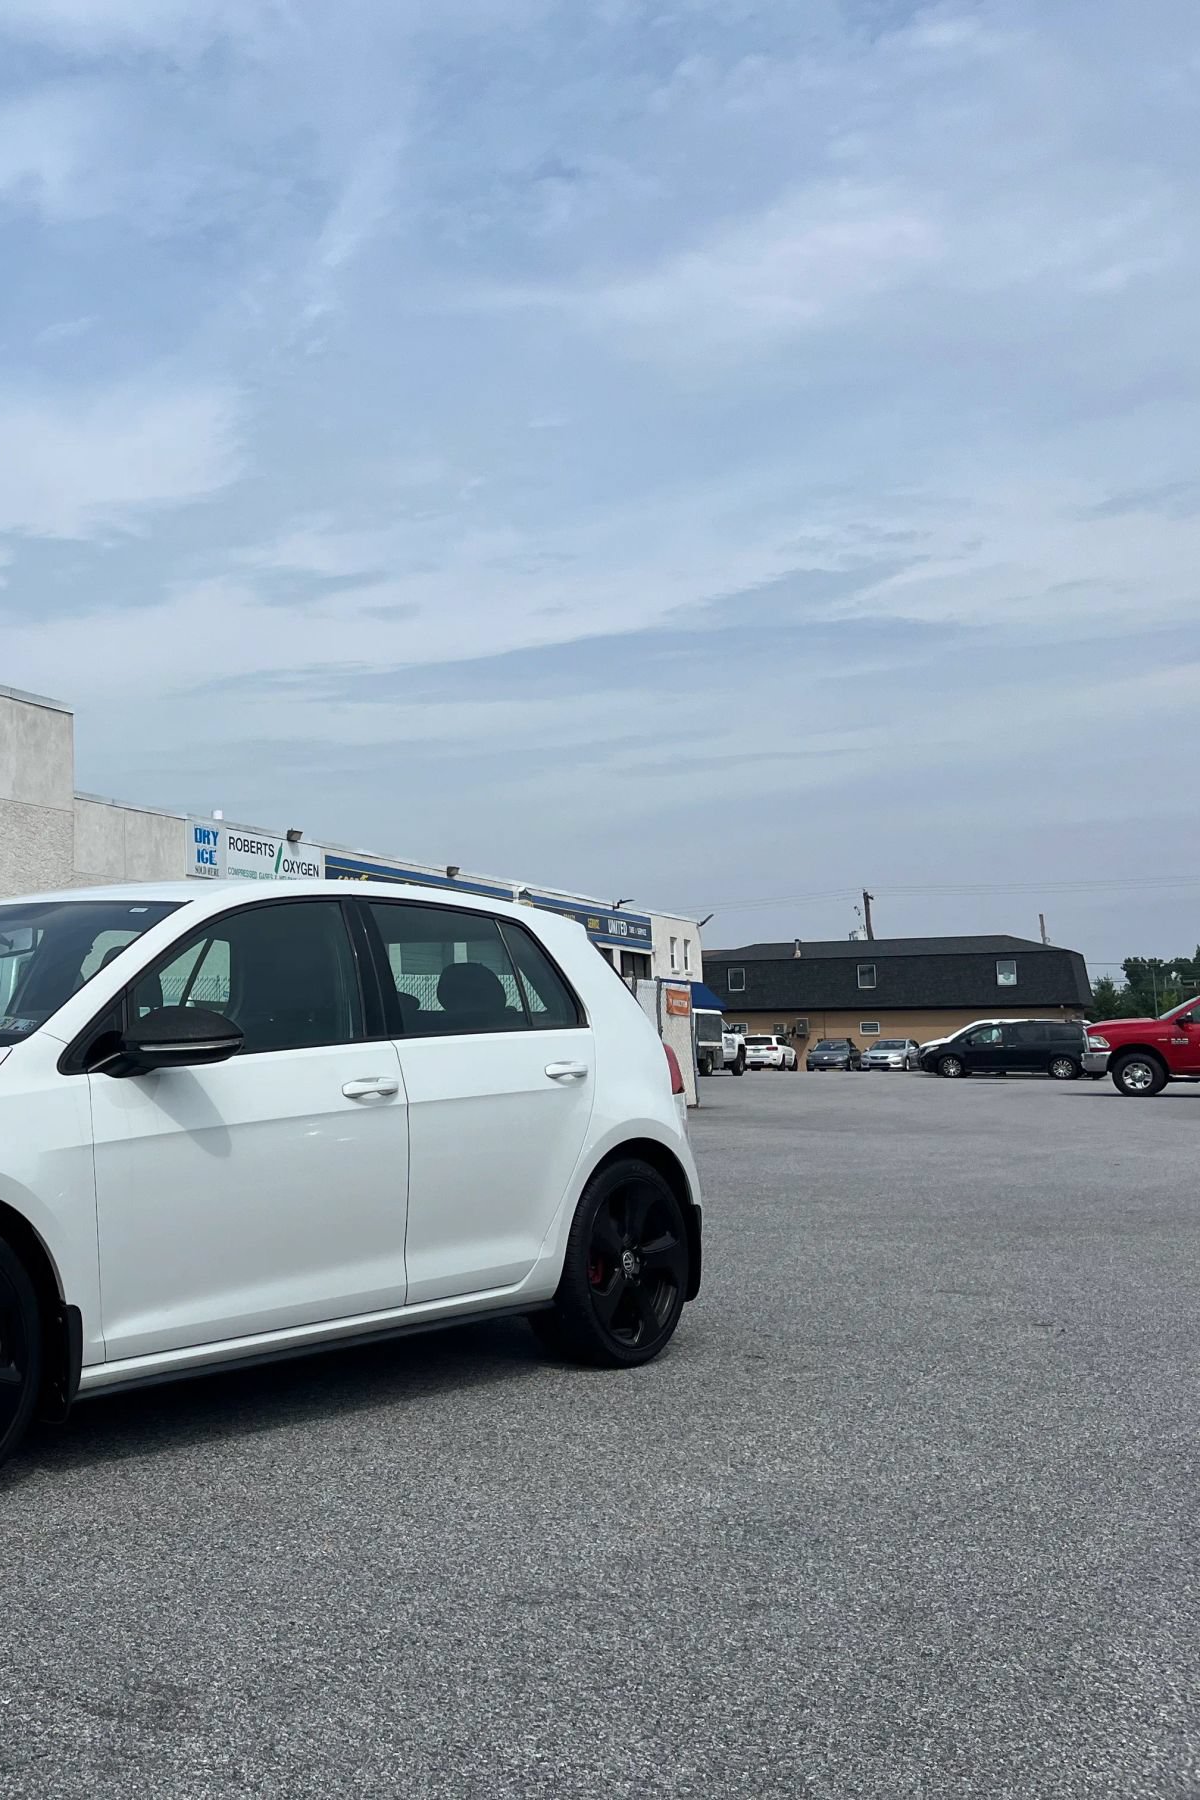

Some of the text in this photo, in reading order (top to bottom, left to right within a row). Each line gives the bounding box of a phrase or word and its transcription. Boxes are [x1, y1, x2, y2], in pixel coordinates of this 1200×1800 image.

[195, 828, 218, 846] DRY
[197, 849, 217, 865] ICE
[228, 836, 319, 877] ROBERTS OXYGEN
[607, 919, 627, 936] UNITED
